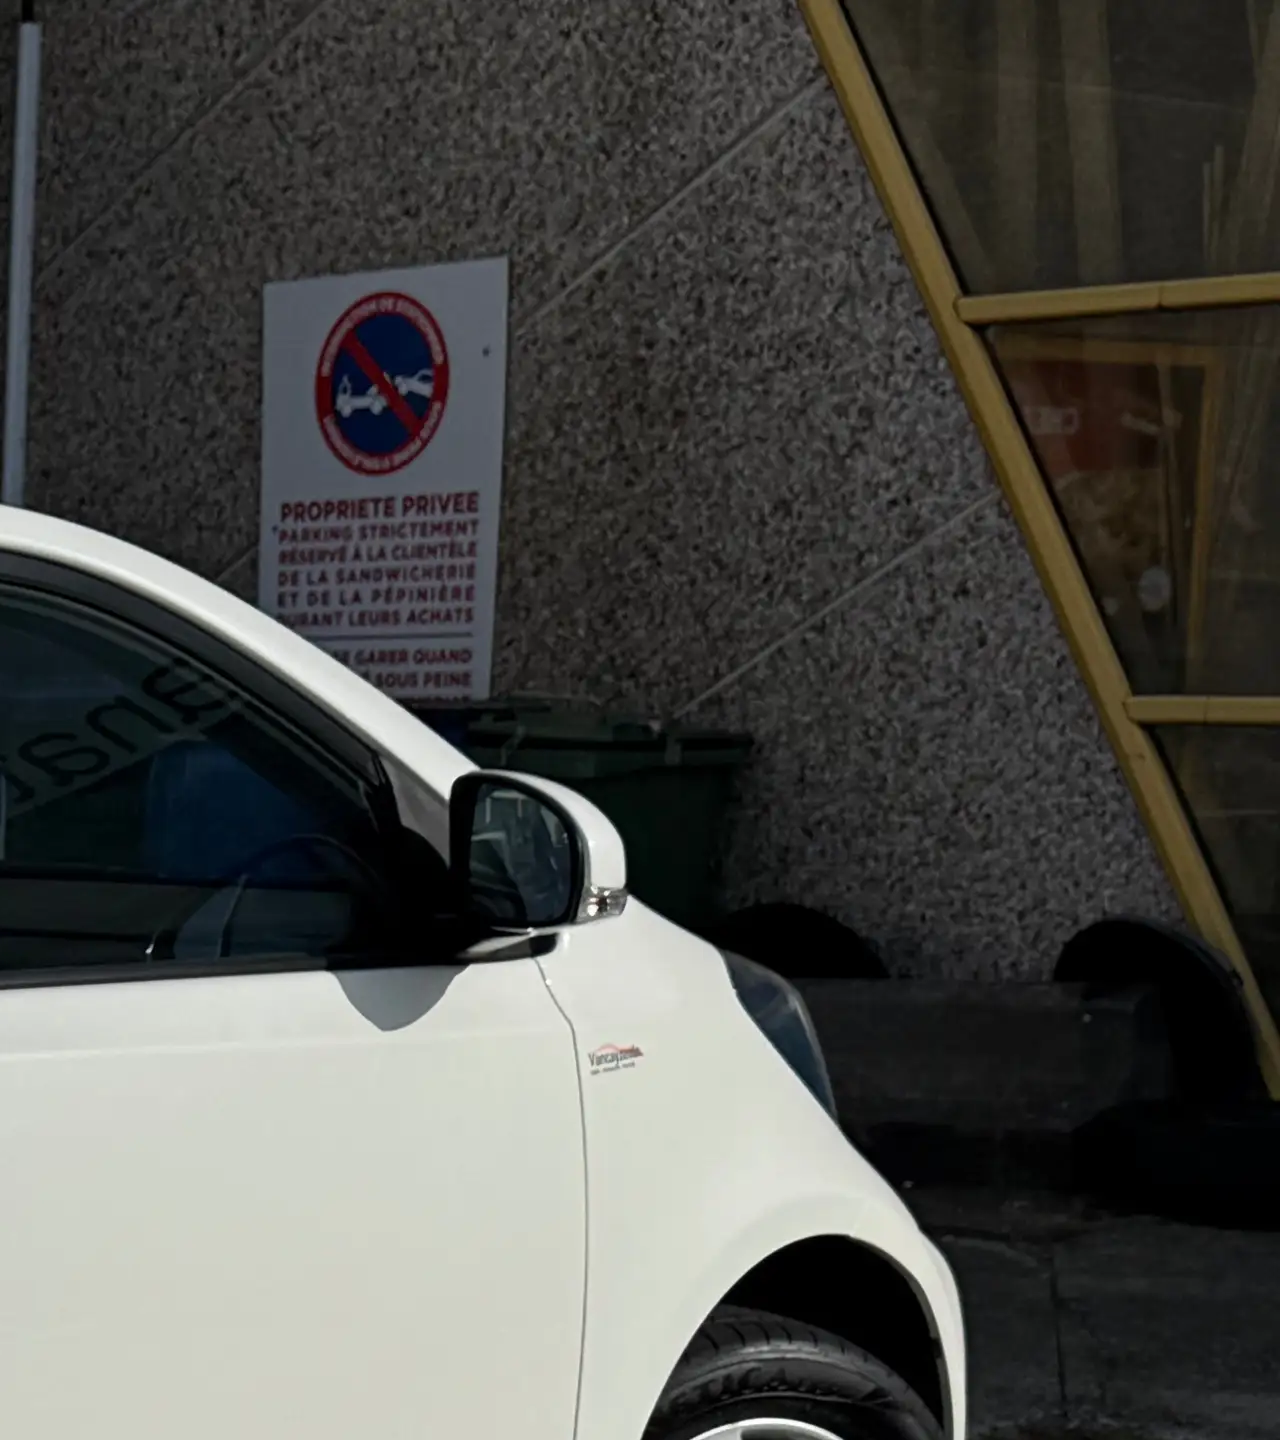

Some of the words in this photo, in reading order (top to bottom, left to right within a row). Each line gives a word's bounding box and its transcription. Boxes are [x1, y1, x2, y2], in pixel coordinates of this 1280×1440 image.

[278, 525, 354, 544] PARKING
[359, 518, 480, 542] STRICTEMENT
[367, 546, 386, 562] LA
[277, 570, 299, 588] DE
[306, 569, 329, 586] LA
[335, 563, 476, 586] SANDWICHERIE
[277, 590, 299, 609] ET
[306, 589, 330, 607] DE
[338, 588, 363, 606] LA
[348, 609, 401, 627] LEURS
[406, 607, 474, 626] ACHATS
[353, 648, 409, 664] GARER
[412, 648, 474, 666] QUAND
[422, 671, 472, 689] PEINE
